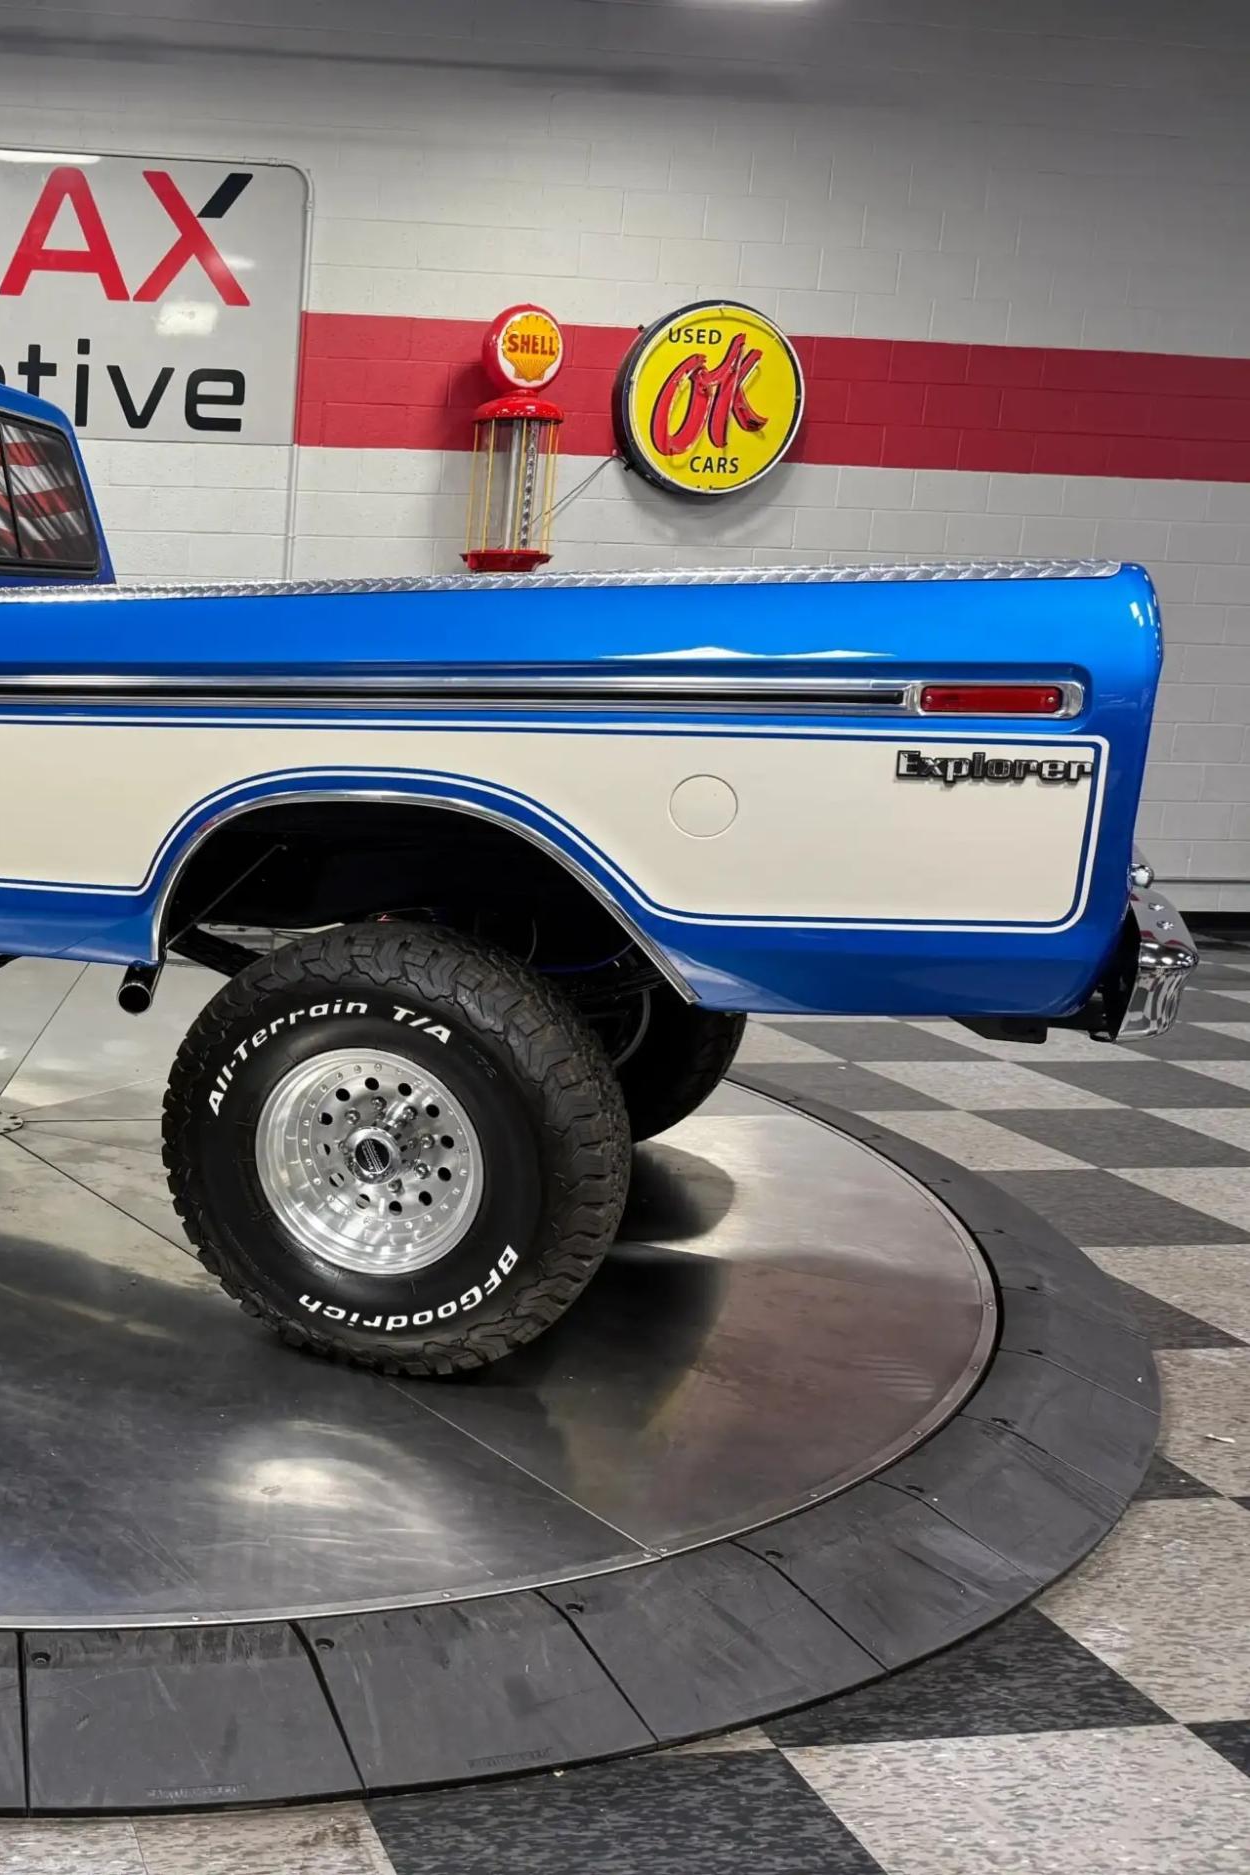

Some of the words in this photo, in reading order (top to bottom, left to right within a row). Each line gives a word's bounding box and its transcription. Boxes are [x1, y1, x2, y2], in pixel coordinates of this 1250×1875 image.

[507, 332, 557, 357] SHELL
[668, 327, 723, 345] USED
[651, 332, 769, 457] OK
[690, 456, 740, 474] CARS
[896, 750, 1094, 785] Explorer
[208, 998, 368, 1116] All-Terrain
[392, 1005, 452, 1046] T/A
[298, 1244, 519, 1332] BFGoodrich
